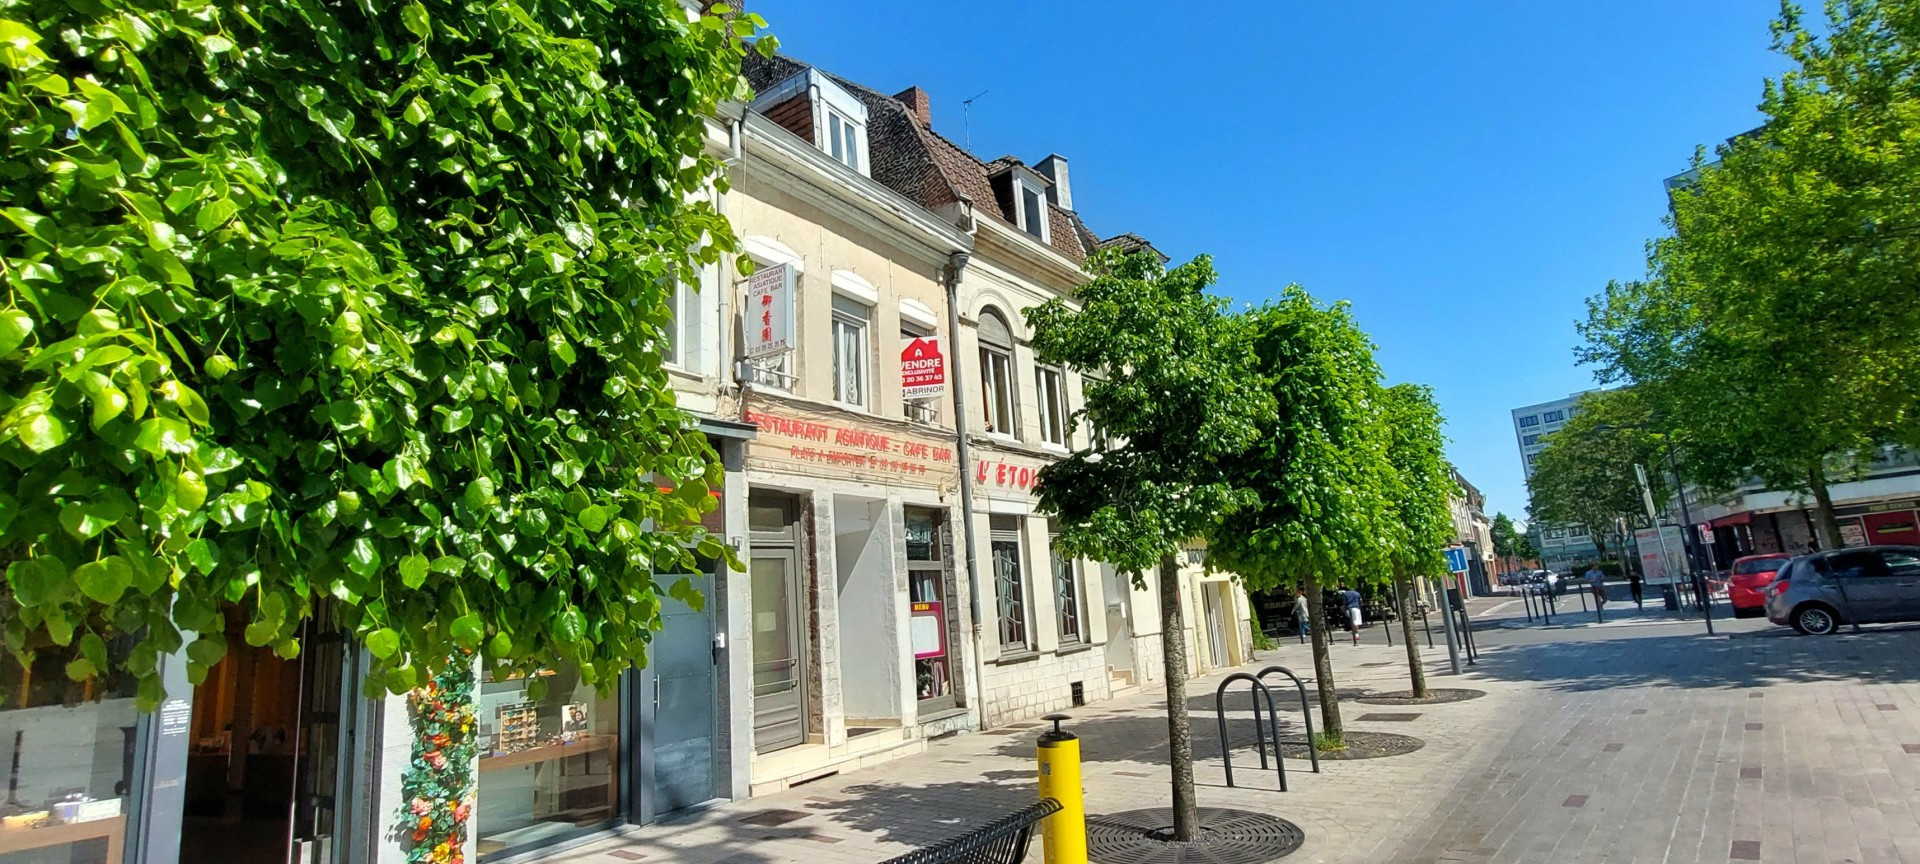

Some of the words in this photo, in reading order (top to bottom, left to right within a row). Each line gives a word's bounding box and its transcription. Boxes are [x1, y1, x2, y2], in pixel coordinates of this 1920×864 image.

[750, 267, 786, 283] RESTAURANT
[753, 275, 782, 290] ASIATIQUE
[770, 283, 783, 292] BAR
[915, 348, 923, 357] A
[906, 386, 944, 394] ABRINOR
[835, 428, 891, 452] ASIATIQUE
[903, 440, 929, 460] CAFE
[932, 446, 952, 464] BAR
[790, 445, 816, 463] PLATS
[914, 603, 930, 611] MENU
